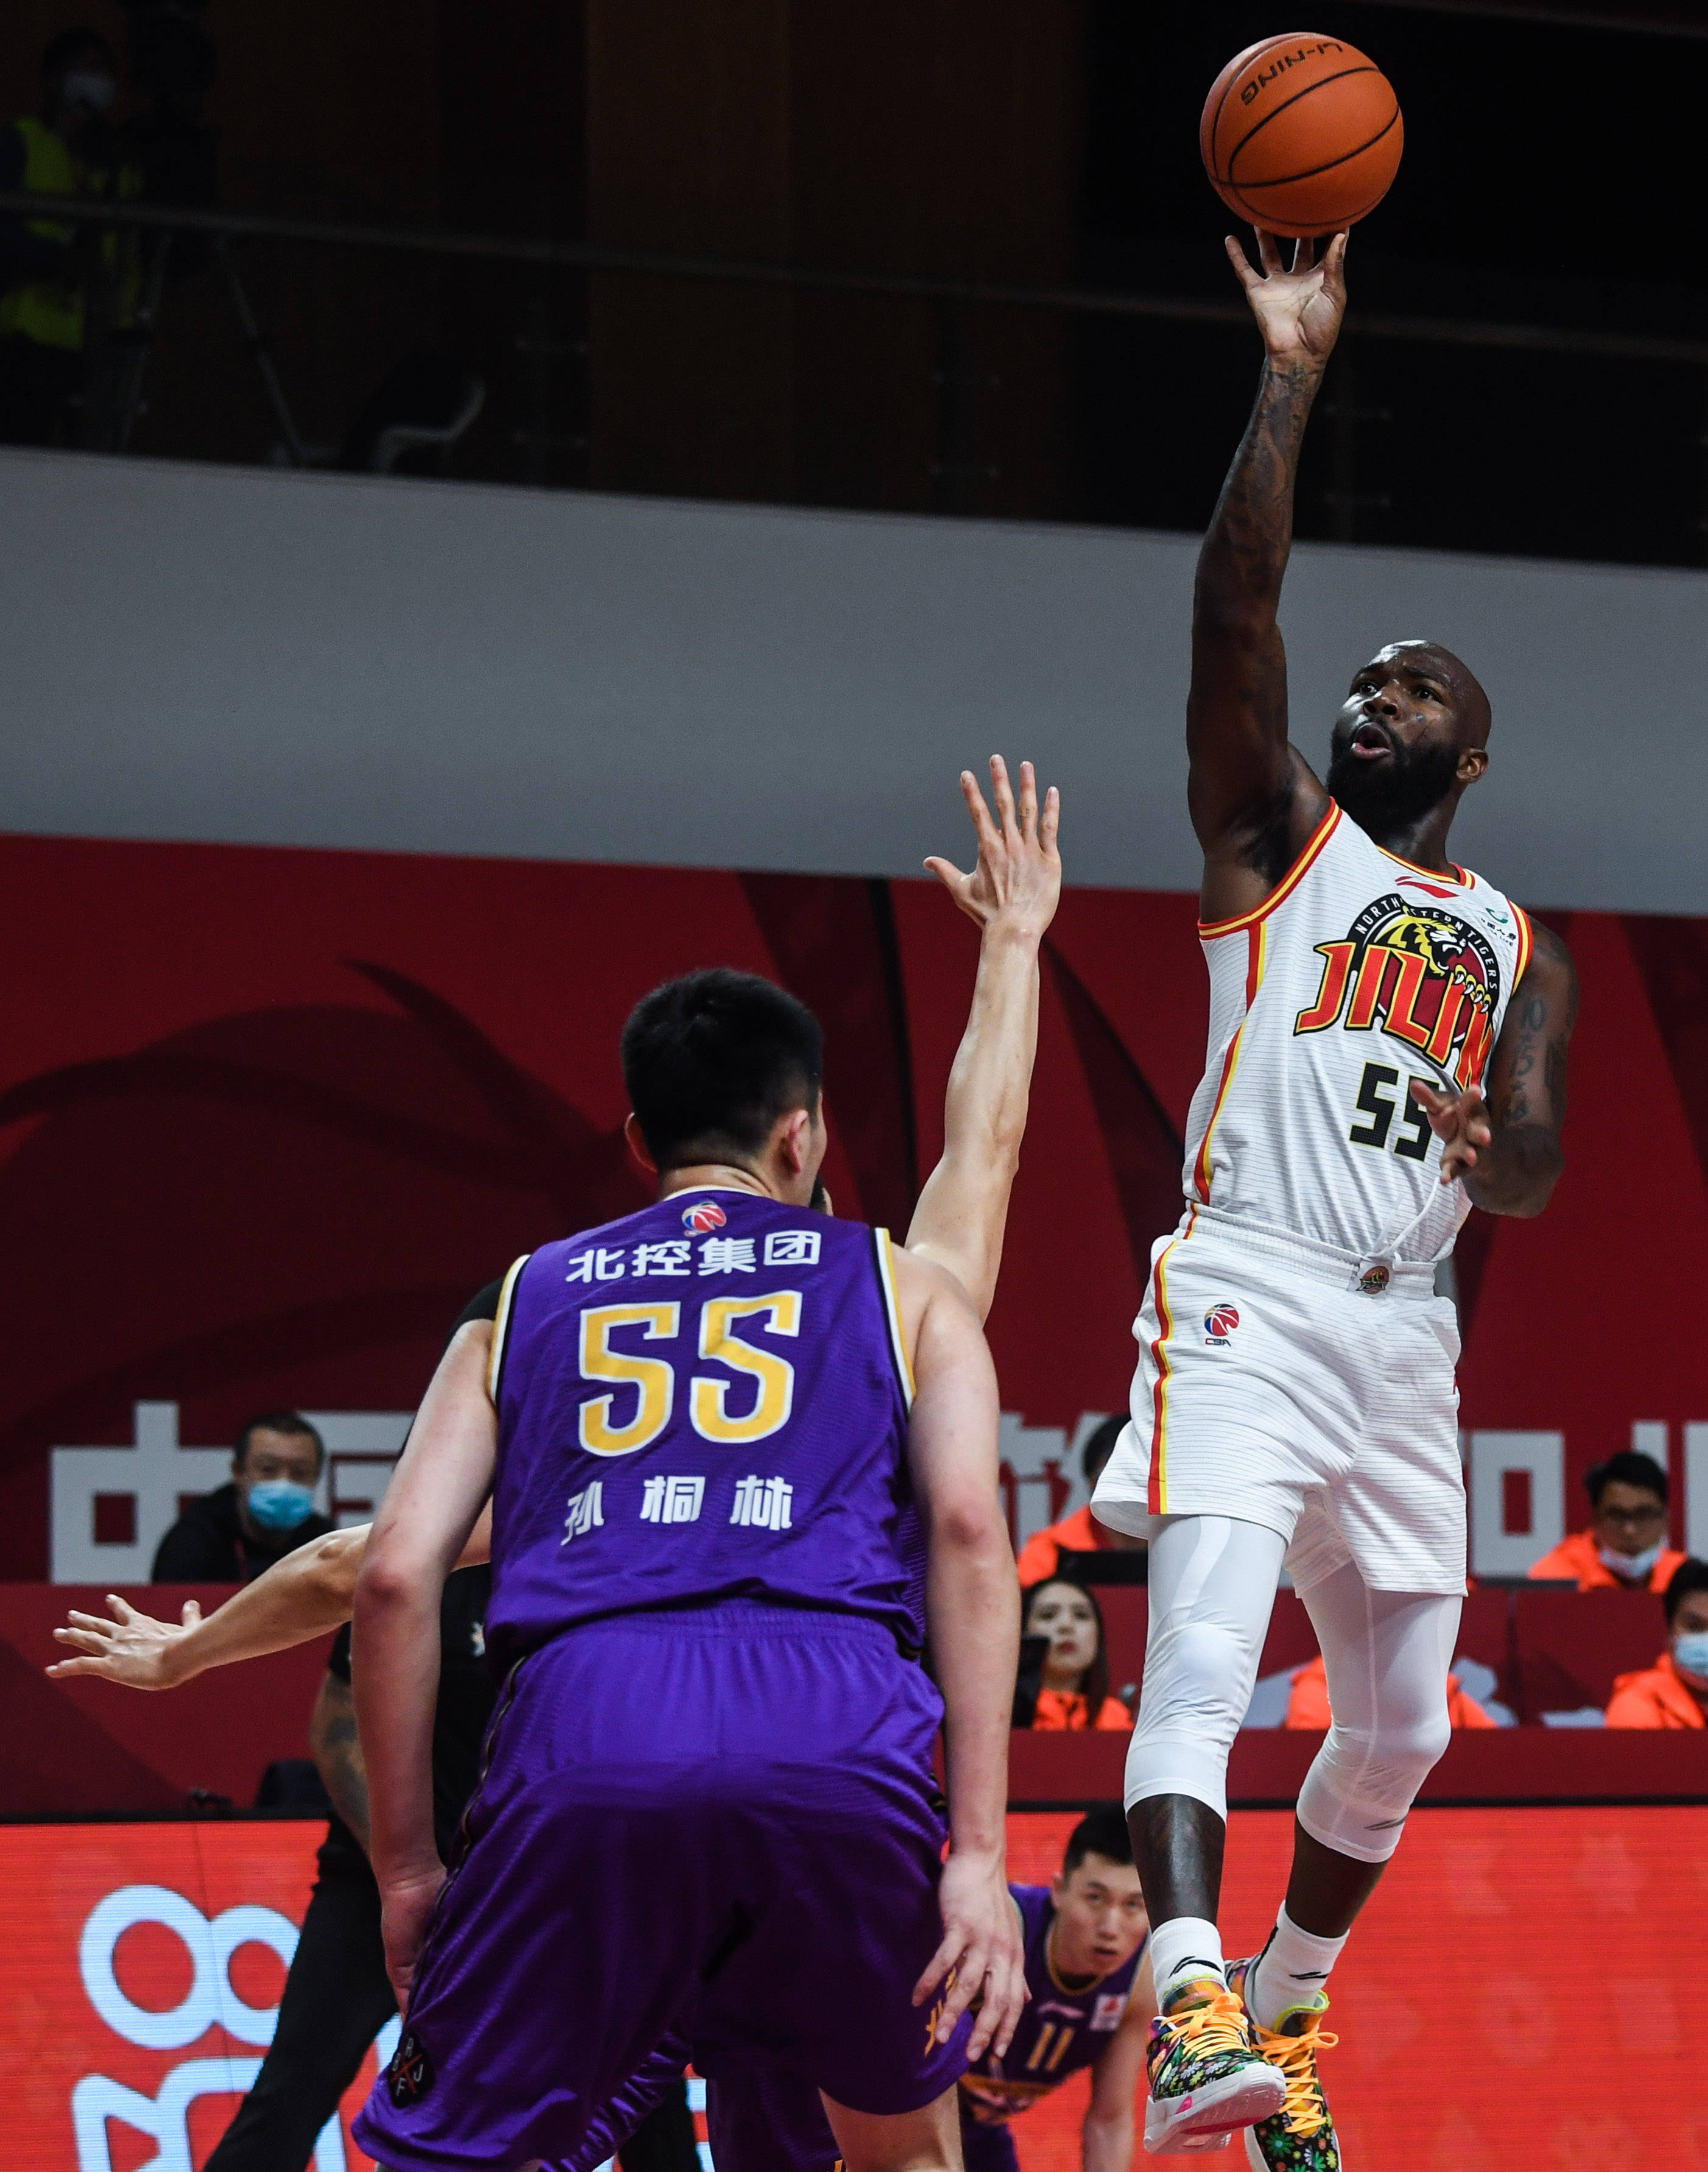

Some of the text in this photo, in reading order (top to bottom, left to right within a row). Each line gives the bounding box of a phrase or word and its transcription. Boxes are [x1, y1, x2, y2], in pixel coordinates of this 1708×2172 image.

[1241, 42, 1343, 106] LI-NING
[1354, 897, 1499, 990] NORTHTERN TIGERS
[1480, 917, 1517, 941] 国人寿
[1293, 940, 1494, 1094] JILIN
[1349, 1062, 1441, 1162] 55
[566, 1230, 821, 1283] 北控集团
[578, 1289, 802, 1458] 55
[1205, 1338, 1231, 1347] CBA
[560, 1475, 793, 1546] 孙桐林
[1027, 2022, 1074, 2071] 11
